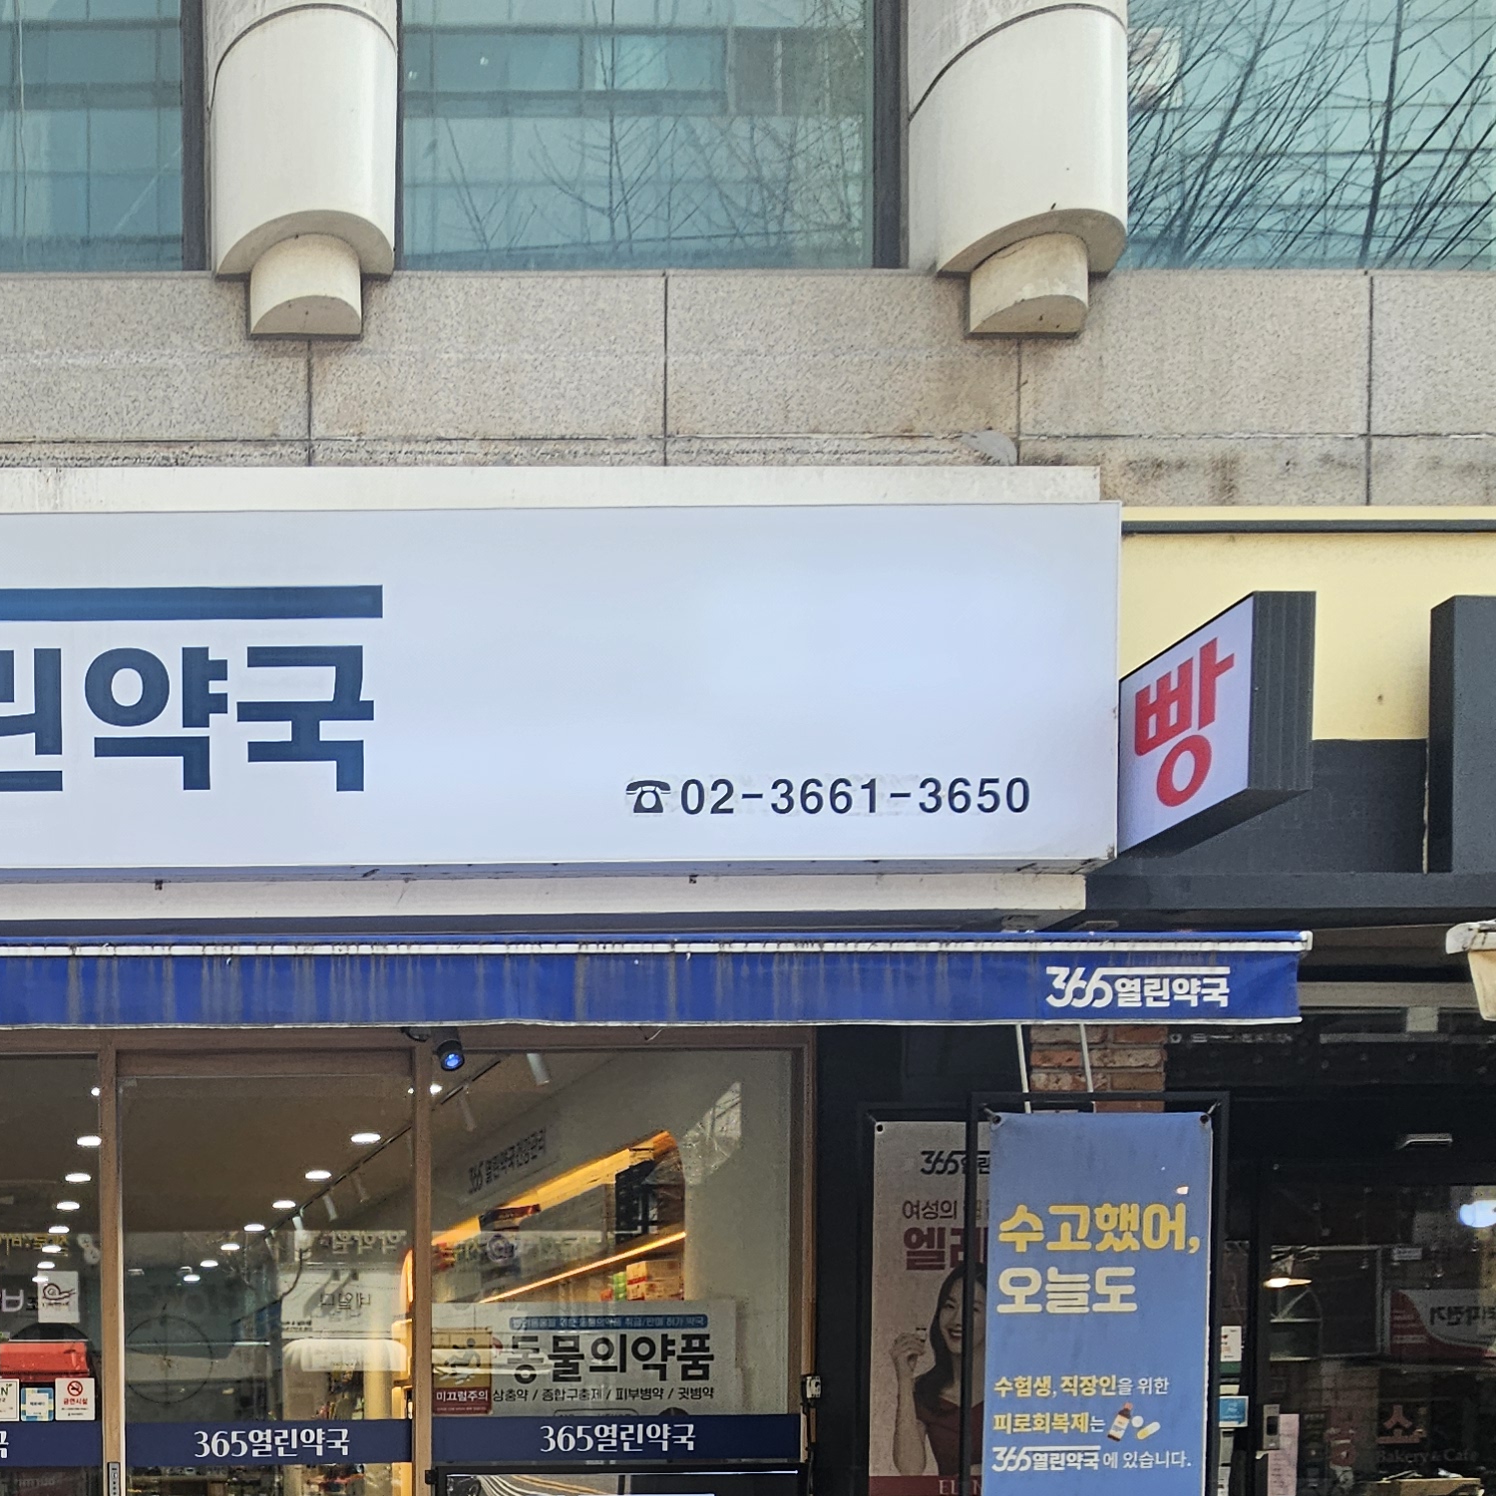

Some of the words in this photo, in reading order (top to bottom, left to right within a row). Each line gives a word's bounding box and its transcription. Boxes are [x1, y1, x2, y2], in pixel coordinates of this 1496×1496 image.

[1133, 637, 1235, 807] 빵
[680, 777, 1031, 814] 02-3661-3650
[1045, 966, 1230, 1008] 365열린약국
[920, 1150, 990, 1175] 365린
[902, 1200, 957, 1220] 여성의
[998, 1203, 1201, 1256] 수고했어,
[997, 1266, 1138, 1315] 오늘도
[507, 1333, 714, 1385] 동물의약품
[436, 1390, 489, 1402] 미끄럼주의
[542, 1388, 602, 1402] 종합구충제
[616, 1387, 664, 1401] 피부병약
[993, 1375, 1058, 1400] 수험생,
[1060, 1373, 1133, 1399] 직장인을
[1137, 1374, 1169, 1397] 위한
[63, 1397, 88, 1406] 금연시설
[992, 1411, 1106, 1435] 피로회복제는
[194, 1429, 350, 1458] 365열린약국
[540, 1423, 696, 1452] 365열린약국
[1122, 1447, 1192, 1469] 있습니다.
